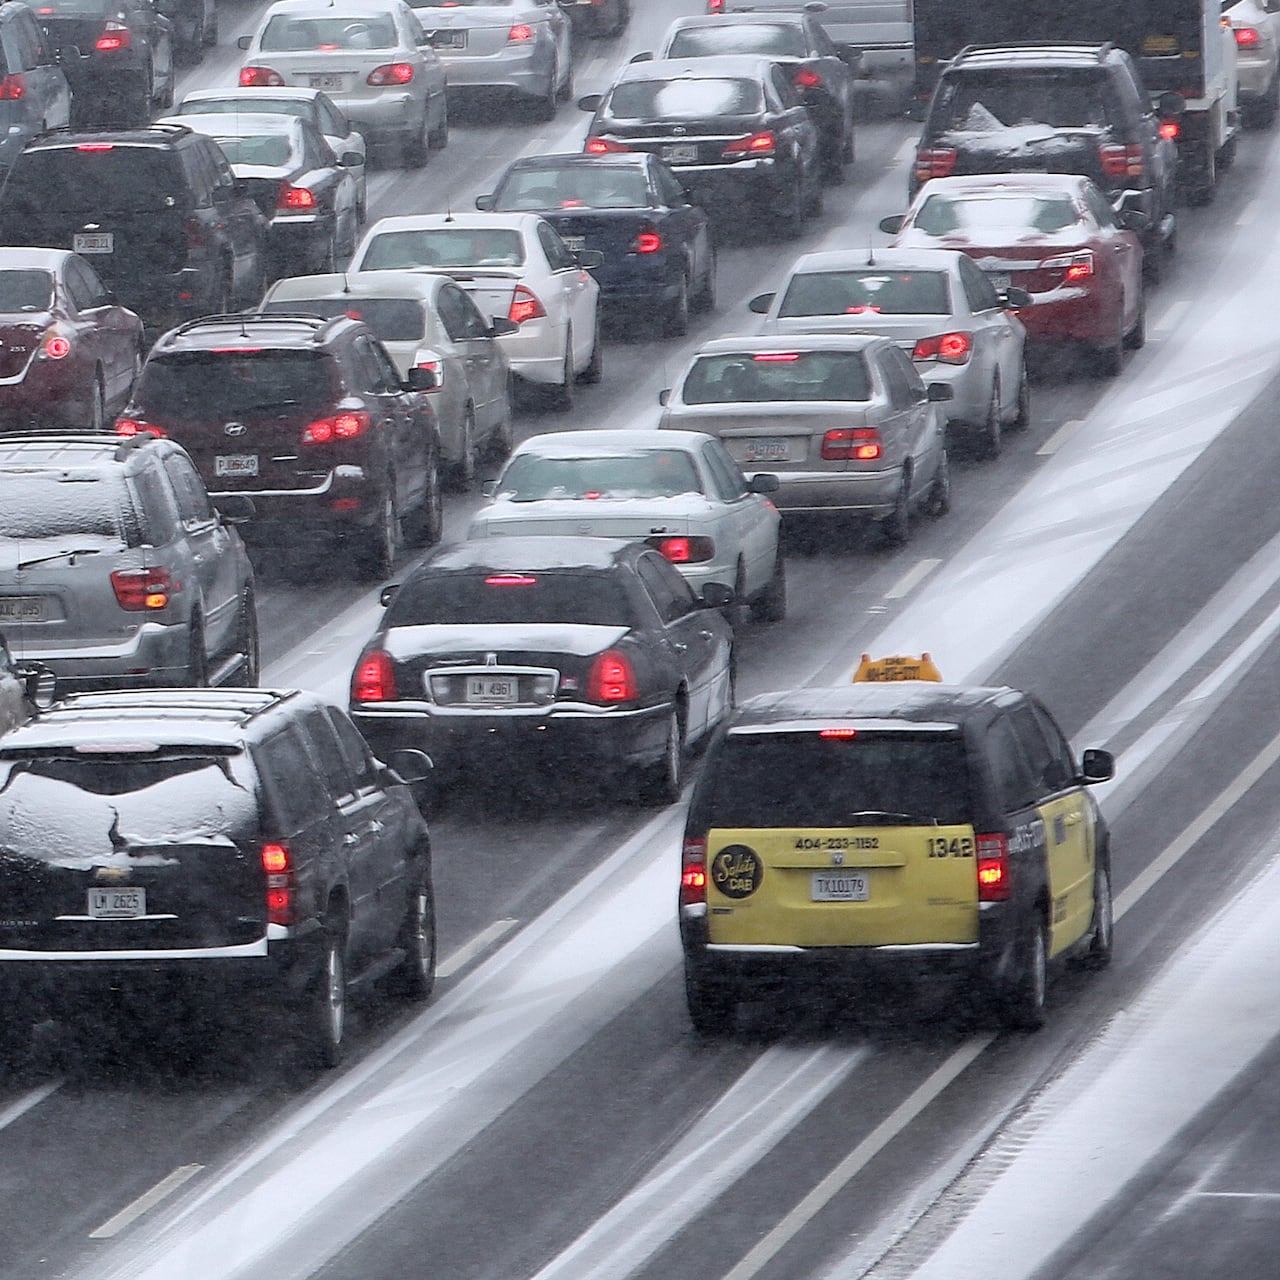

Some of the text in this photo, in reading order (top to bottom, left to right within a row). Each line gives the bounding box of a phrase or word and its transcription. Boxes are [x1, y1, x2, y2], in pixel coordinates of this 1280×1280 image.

[795, 837, 974, 858] 404-233-1152 1342
[716, 853, 756, 882] Safety
[729, 878, 753, 891] CAB
[817, 878, 864, 894] TX10179
